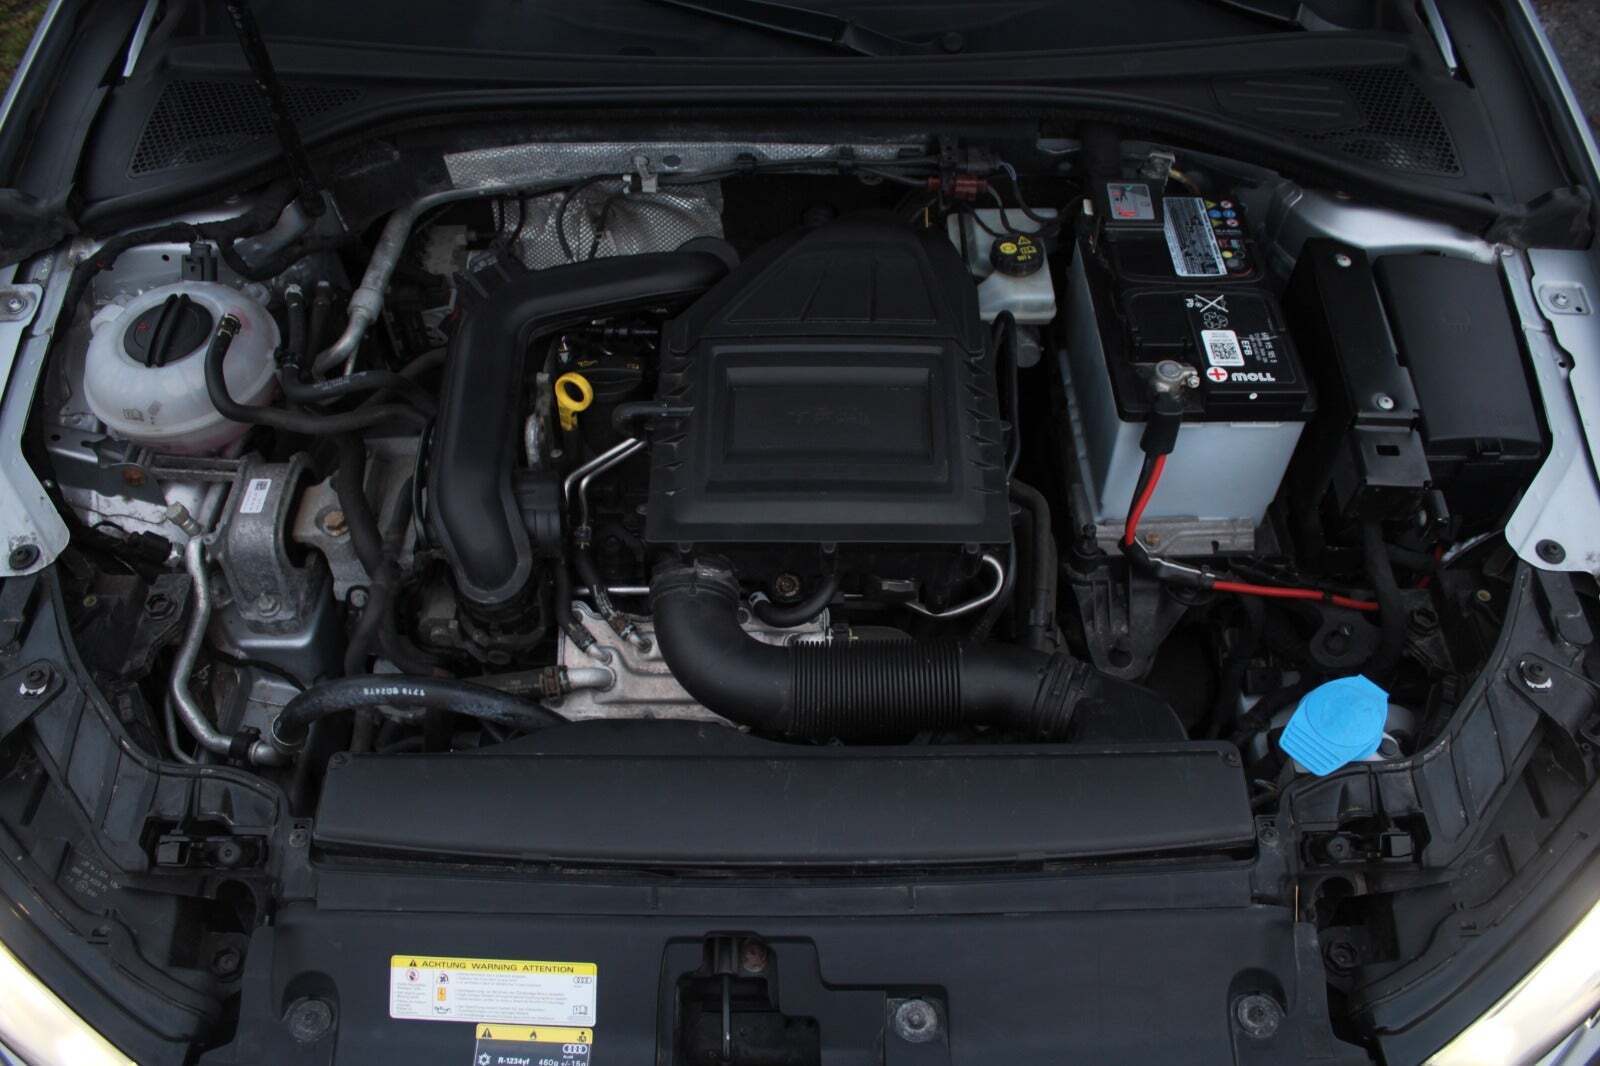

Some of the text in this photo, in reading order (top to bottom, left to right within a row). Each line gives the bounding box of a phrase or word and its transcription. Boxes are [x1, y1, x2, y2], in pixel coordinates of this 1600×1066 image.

[422, 960, 574, 973] ACHTUNG WARNING ATTENTION
